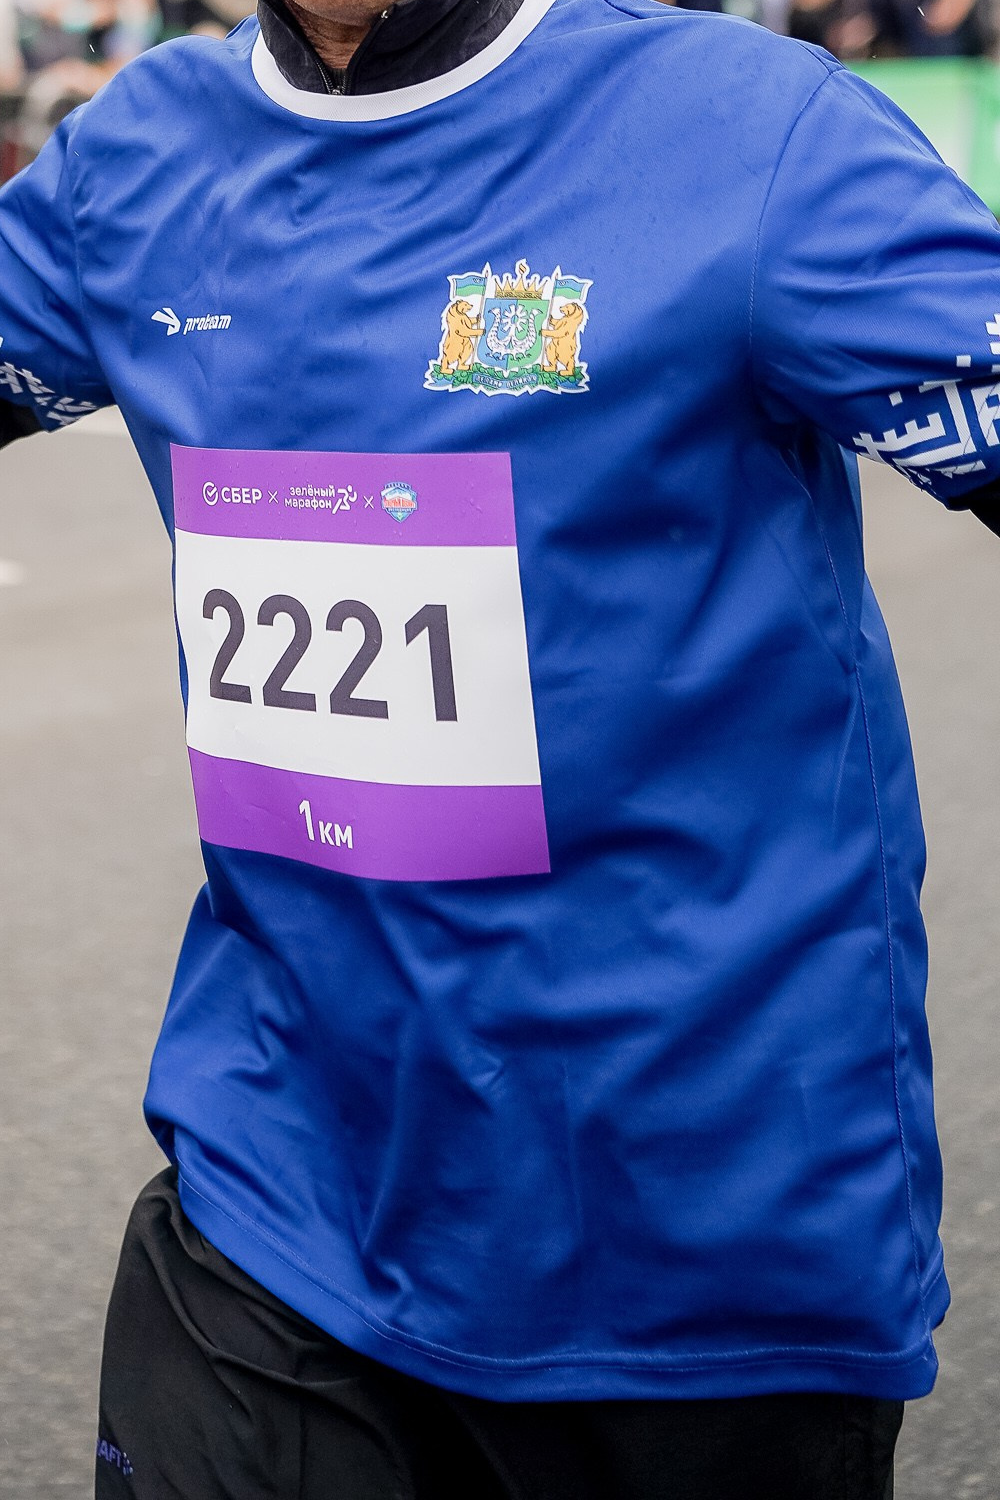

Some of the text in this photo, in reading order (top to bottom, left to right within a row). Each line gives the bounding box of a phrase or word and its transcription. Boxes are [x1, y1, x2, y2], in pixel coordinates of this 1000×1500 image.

[221, 486, 262, 504] СБЕР
[289, 484, 335, 498] зелёный
[284, 497, 332, 510] марафон
[202, 588, 458, 722] 2221
